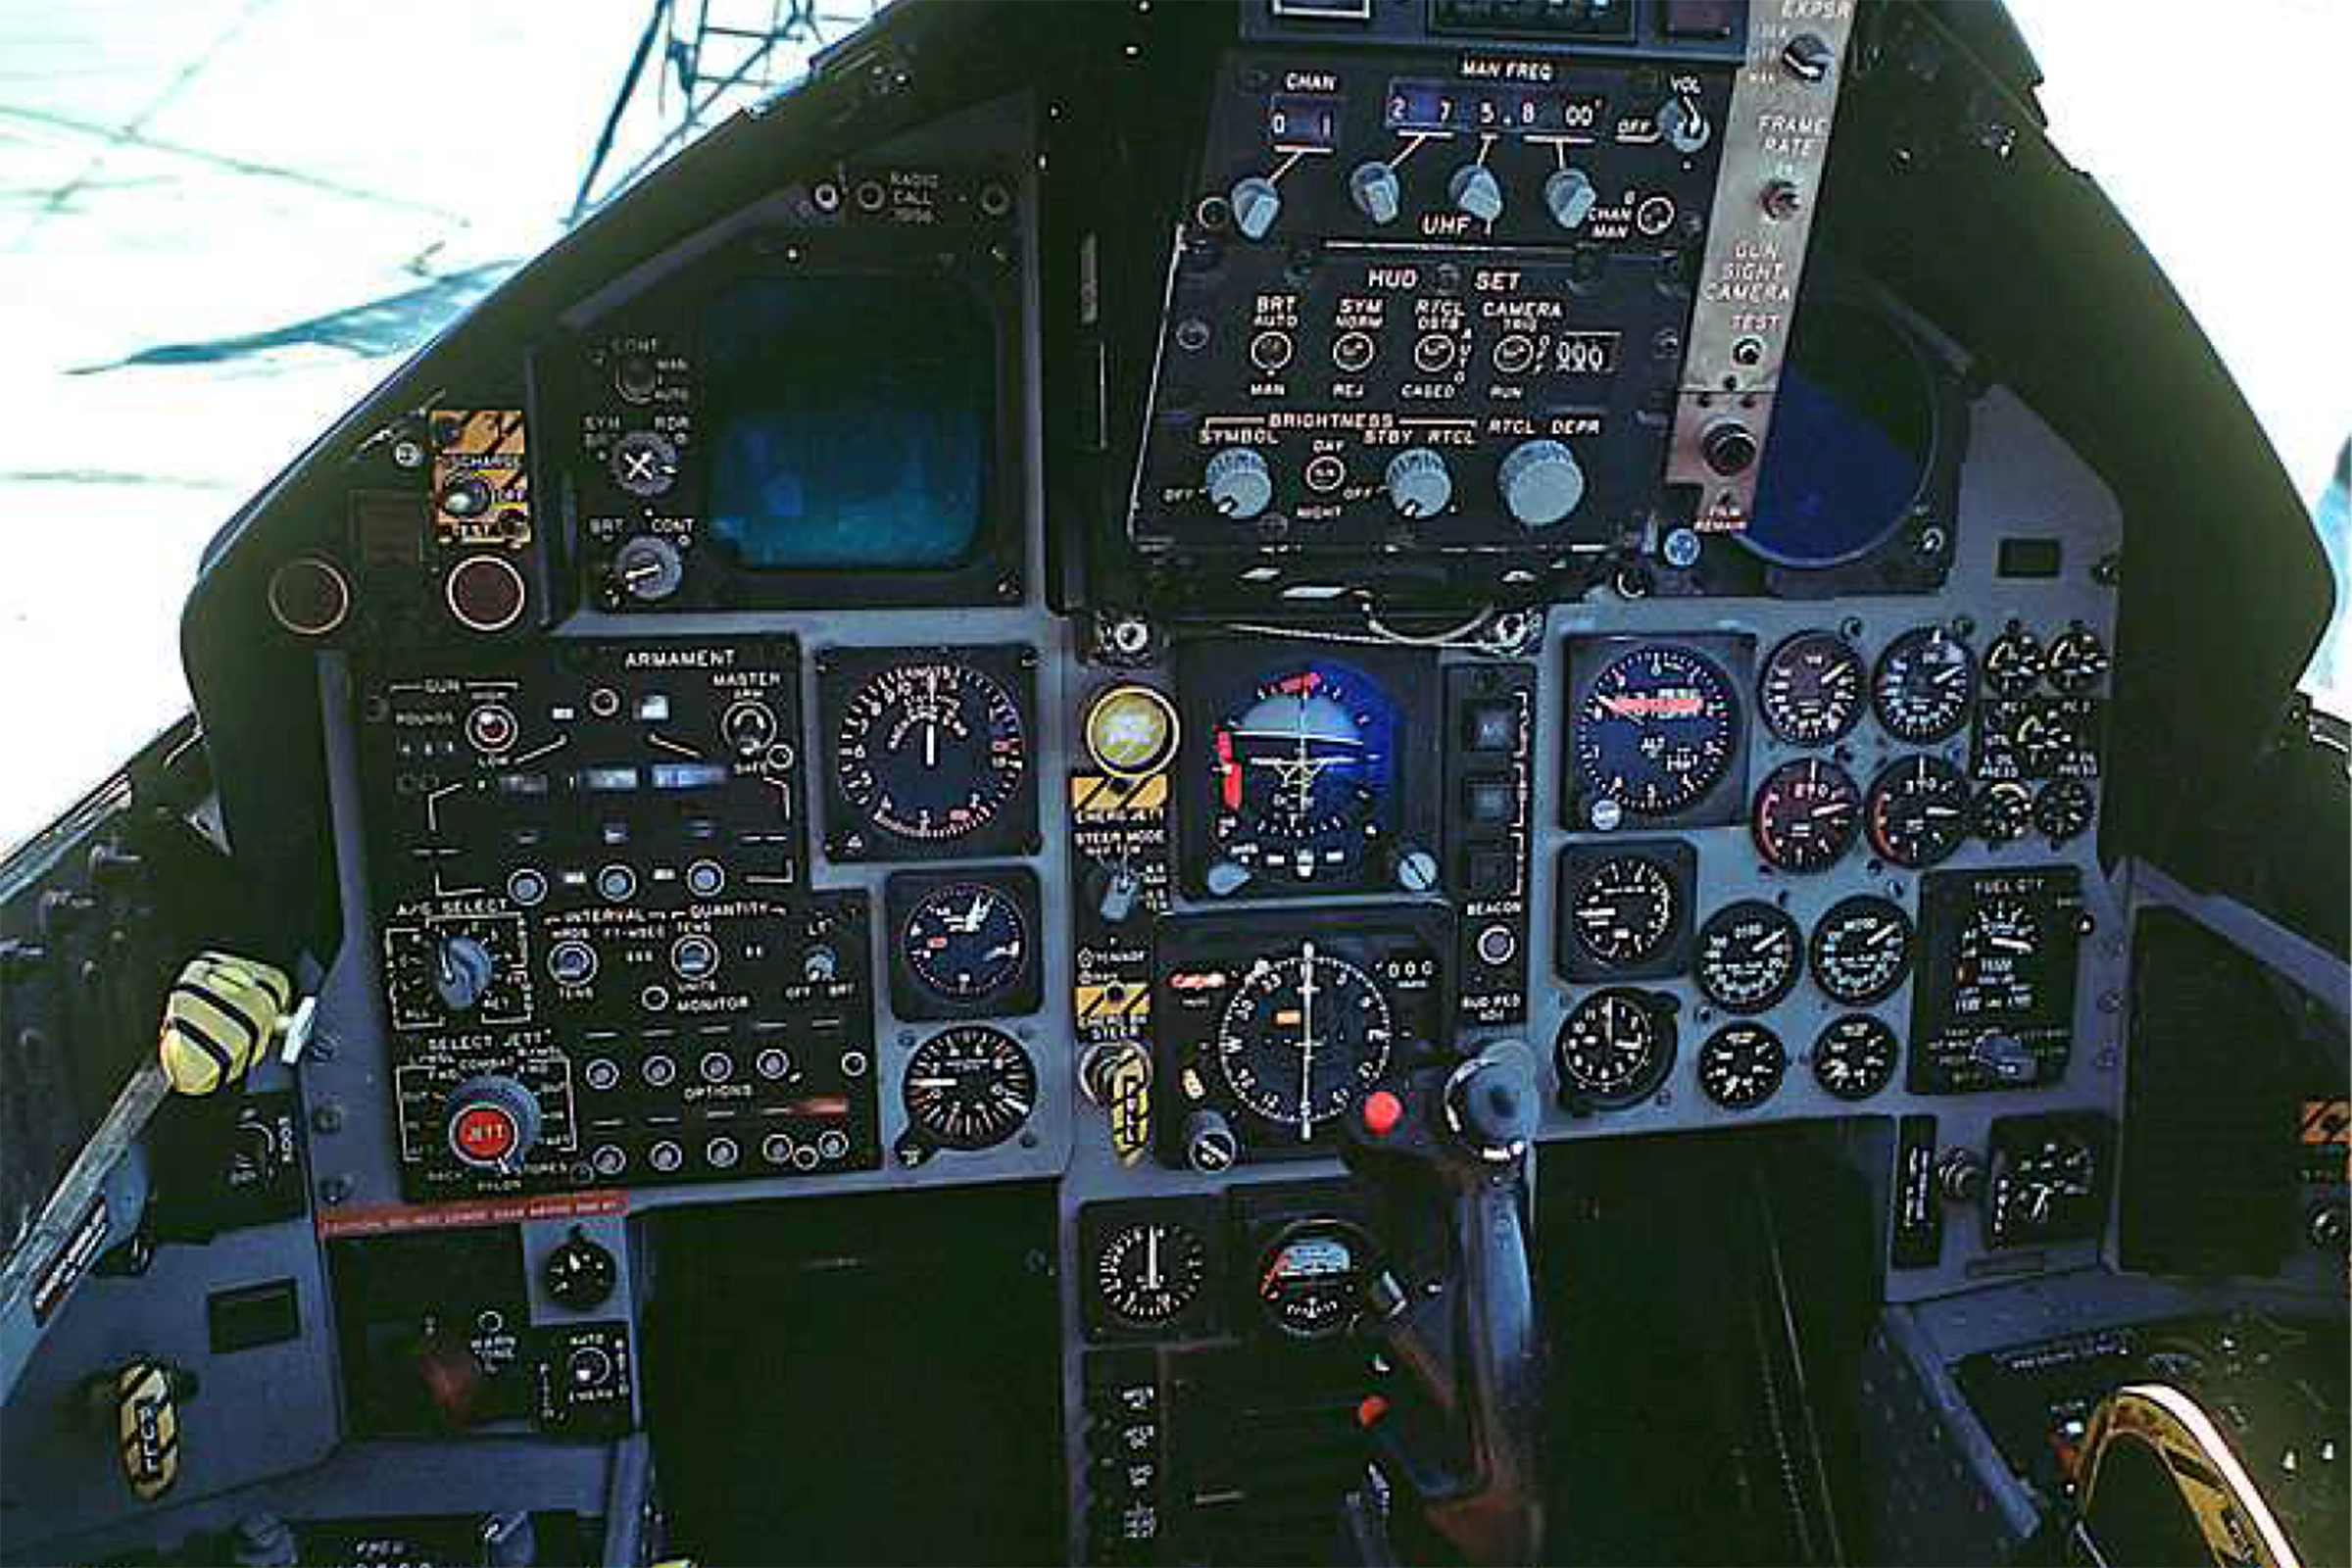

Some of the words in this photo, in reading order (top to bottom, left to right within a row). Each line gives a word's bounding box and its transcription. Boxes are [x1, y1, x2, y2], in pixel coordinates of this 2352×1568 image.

[1463, 59, 1501, 75] MAN
[1506, 60, 1552, 81] FREQ
[1286, 72, 1336, 91] CHAN
[1618, 119, 1651, 134] OFF
[1758, 116, 1830, 135] FRAME
[1422, 215, 1469, 235] UHF
[1368, 269, 1419, 288] HUD
[1474, 271, 1521, 292] SET
[1705, 282, 1792, 302] CAMERA
[1256, 296, 1297, 314] BRT
[1340, 299, 1384, 315] SYM
[1482, 302, 1563, 318] CAMERA
[1730, 315, 1783, 332] TEST
[1268, 413, 1395, 429] BRIGHTNESS
[1199, 428, 1280, 444] SYMBOL
[1362, 429, 1412, 445] STBY
[651, 518, 696, 533] CONT
[625, 649, 735, 668] ARMAMENT
[712, 671, 782, 687] MASTER
[440, 897, 510, 915] SELECT
[689, 901, 769, 920] QUANTITY
[1466, 903, 1522, 917] BEACON
[564, 906, 648, 924] INTERVAL
[677, 995, 753, 1013] MONITOR
[427, 1036, 493, 1052] SELECT
[684, 1084, 753, 1101] OPTIONS
